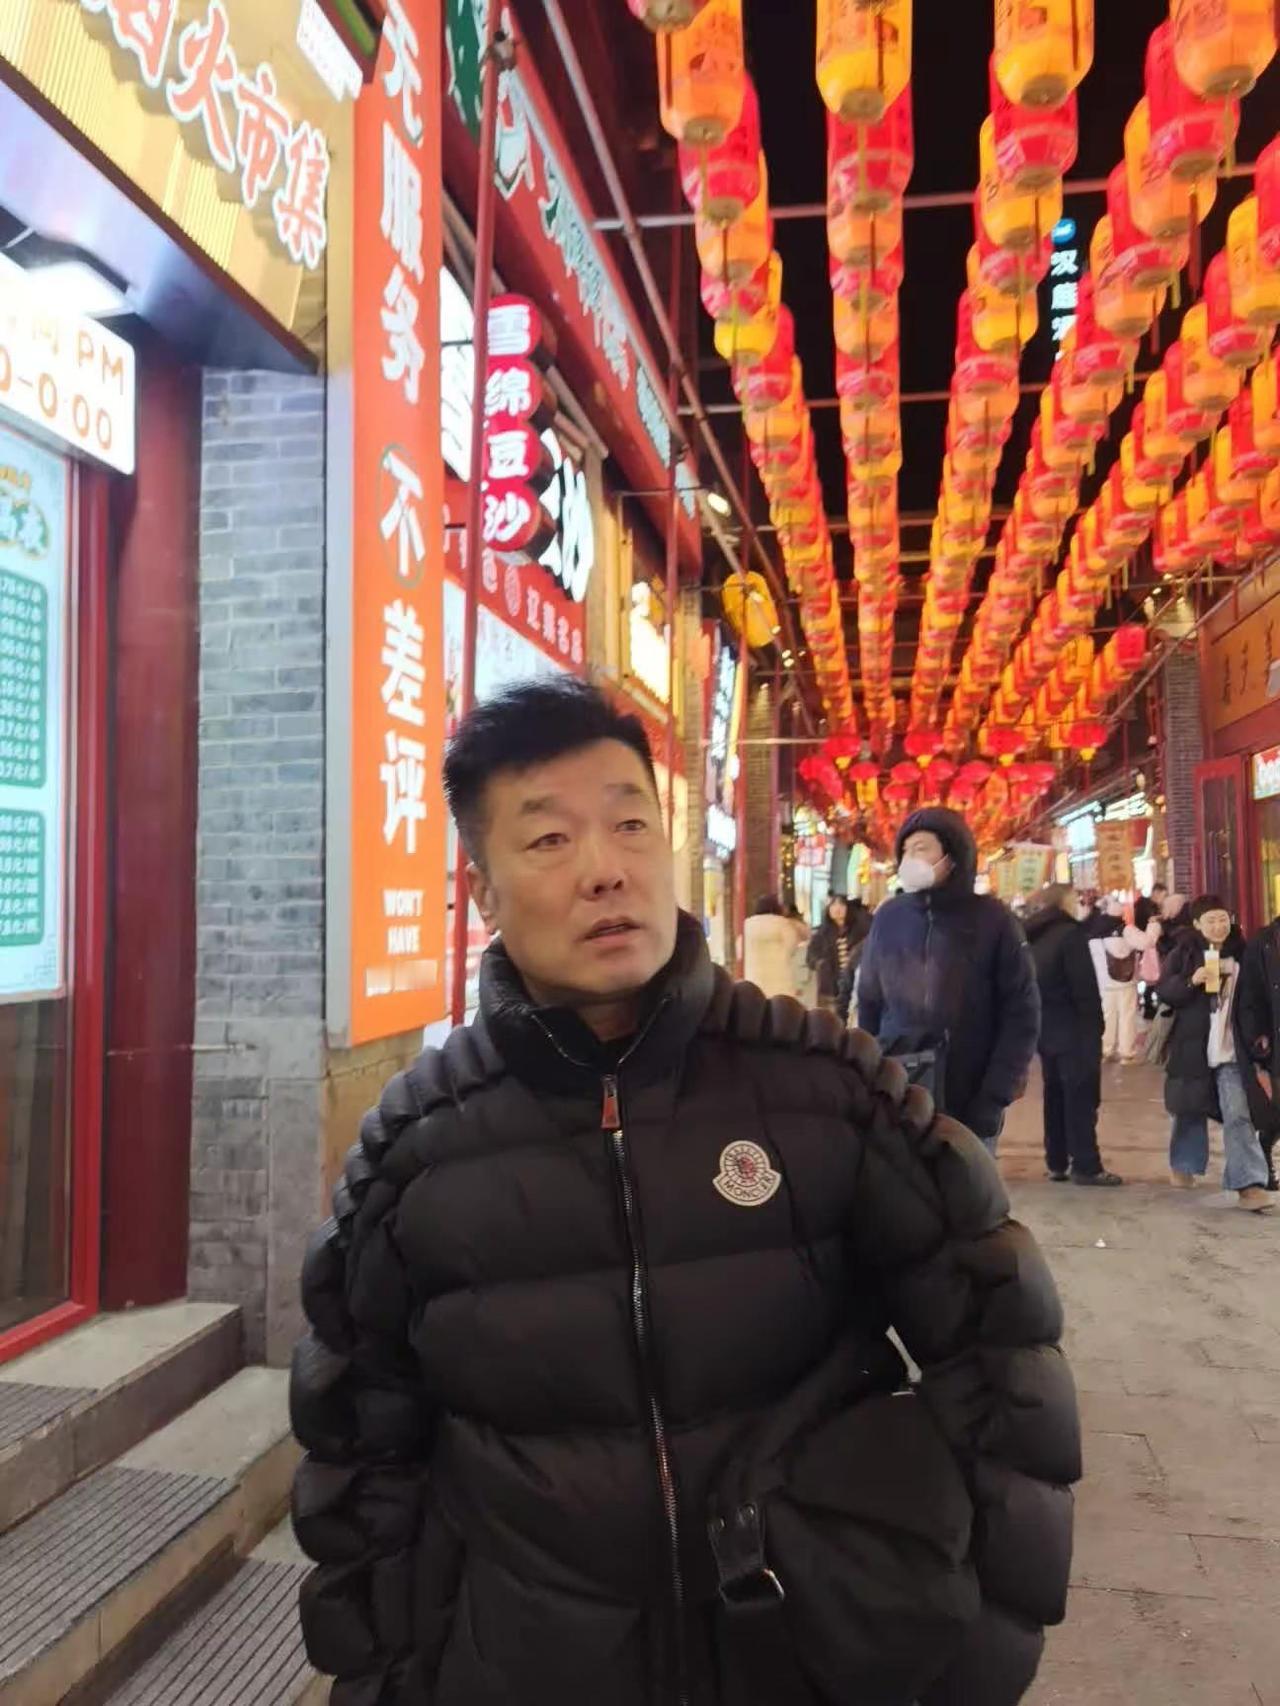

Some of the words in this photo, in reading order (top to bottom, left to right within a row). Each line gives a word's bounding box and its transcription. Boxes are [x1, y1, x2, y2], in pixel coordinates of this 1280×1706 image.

[77, 329, 124, 396] PM
[380, 449, 427, 854] 不差评
